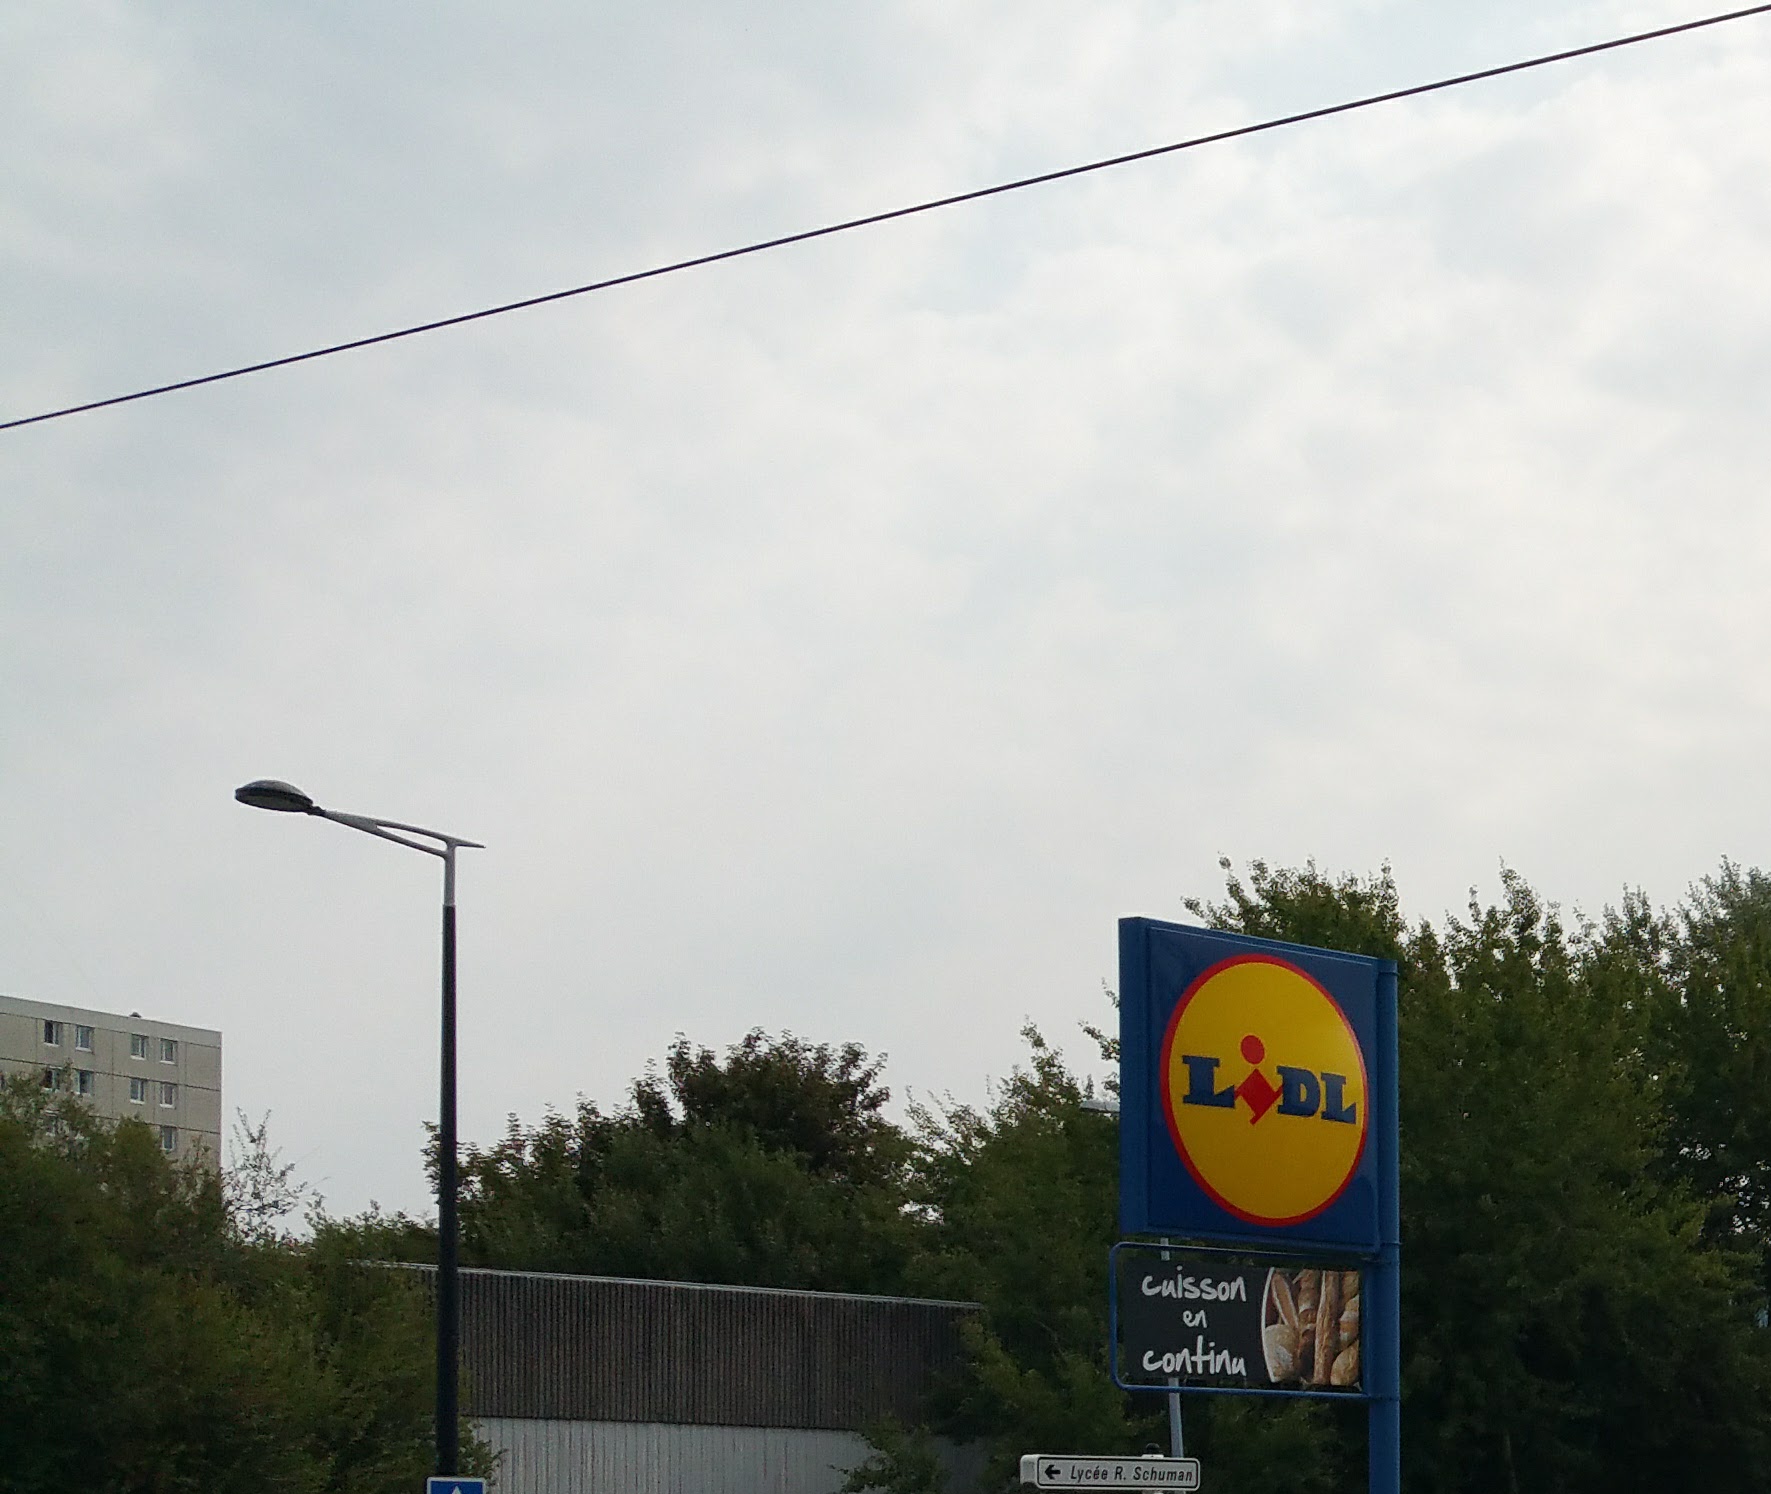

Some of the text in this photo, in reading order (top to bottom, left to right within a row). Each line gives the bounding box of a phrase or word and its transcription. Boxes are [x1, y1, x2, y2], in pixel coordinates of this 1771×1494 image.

[1142, 1265, 1247, 1302] cuisson
[1182, 1309, 1208, 1329] en
[1142, 1334, 1247, 1377] continu
[1070, 1465, 1193, 1483] Lycée R. Schuman
